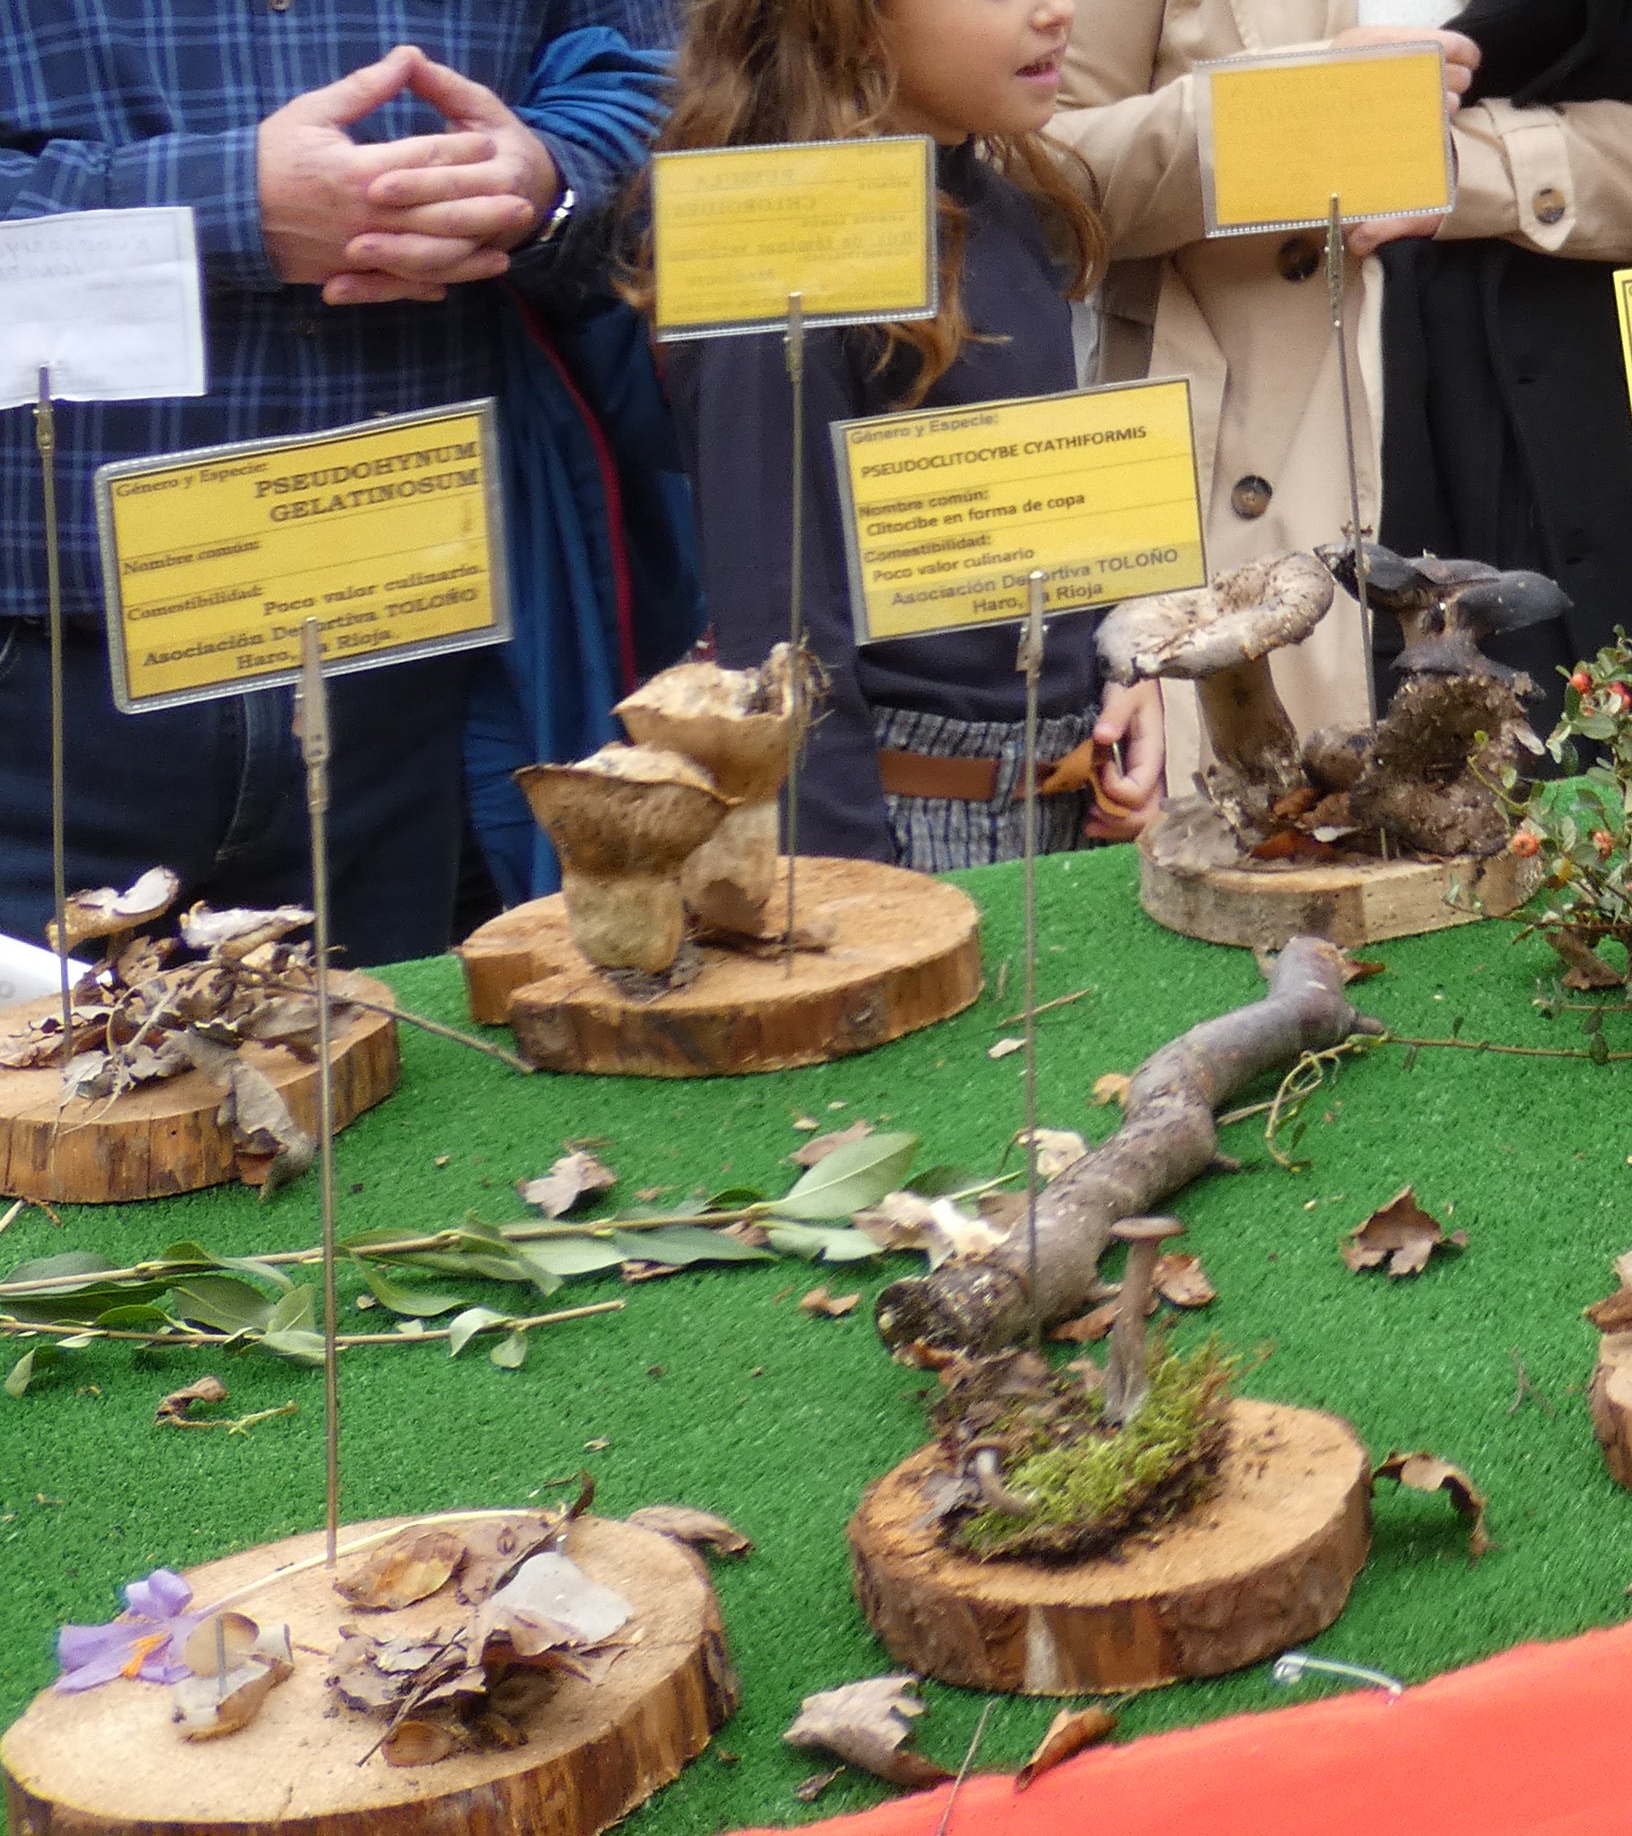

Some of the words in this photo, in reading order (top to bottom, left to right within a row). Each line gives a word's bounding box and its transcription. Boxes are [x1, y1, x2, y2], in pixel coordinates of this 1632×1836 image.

[254, 440, 479, 499] PSEUDOHYNUM
[861, 444, 1018, 479] PSEUDOCLITOCYBE
[1023, 426, 1147, 456] CYATHIFORMIS
[269, 468, 480, 523] GELATINOSUM
[866, 515, 938, 537] Clitocibe
[943, 512, 963, 524] en
[968, 502, 1017, 522] forma
[1022, 498, 1042, 514] de
[1047, 493, 1085, 513] copa
[873, 567, 912, 584] Poco
[917, 559, 958, 576] valor
[963, 546, 1034, 569] culinario
[892, 578, 996, 607] Asociación
[1002, 564, 1091, 591] Deortiva
[1097, 548, 1178, 574] TOLOÑO
[263, 595, 315, 617] Poco
[323, 584, 377, 606] valor
[972, 596, 1024, 615] Haro,
[1056, 582, 1103, 602] Rioja
[143, 630, 265, 667] Asociación
[385, 587, 478, 619] TOLOÑO
[236, 648, 296, 672] Haro,
